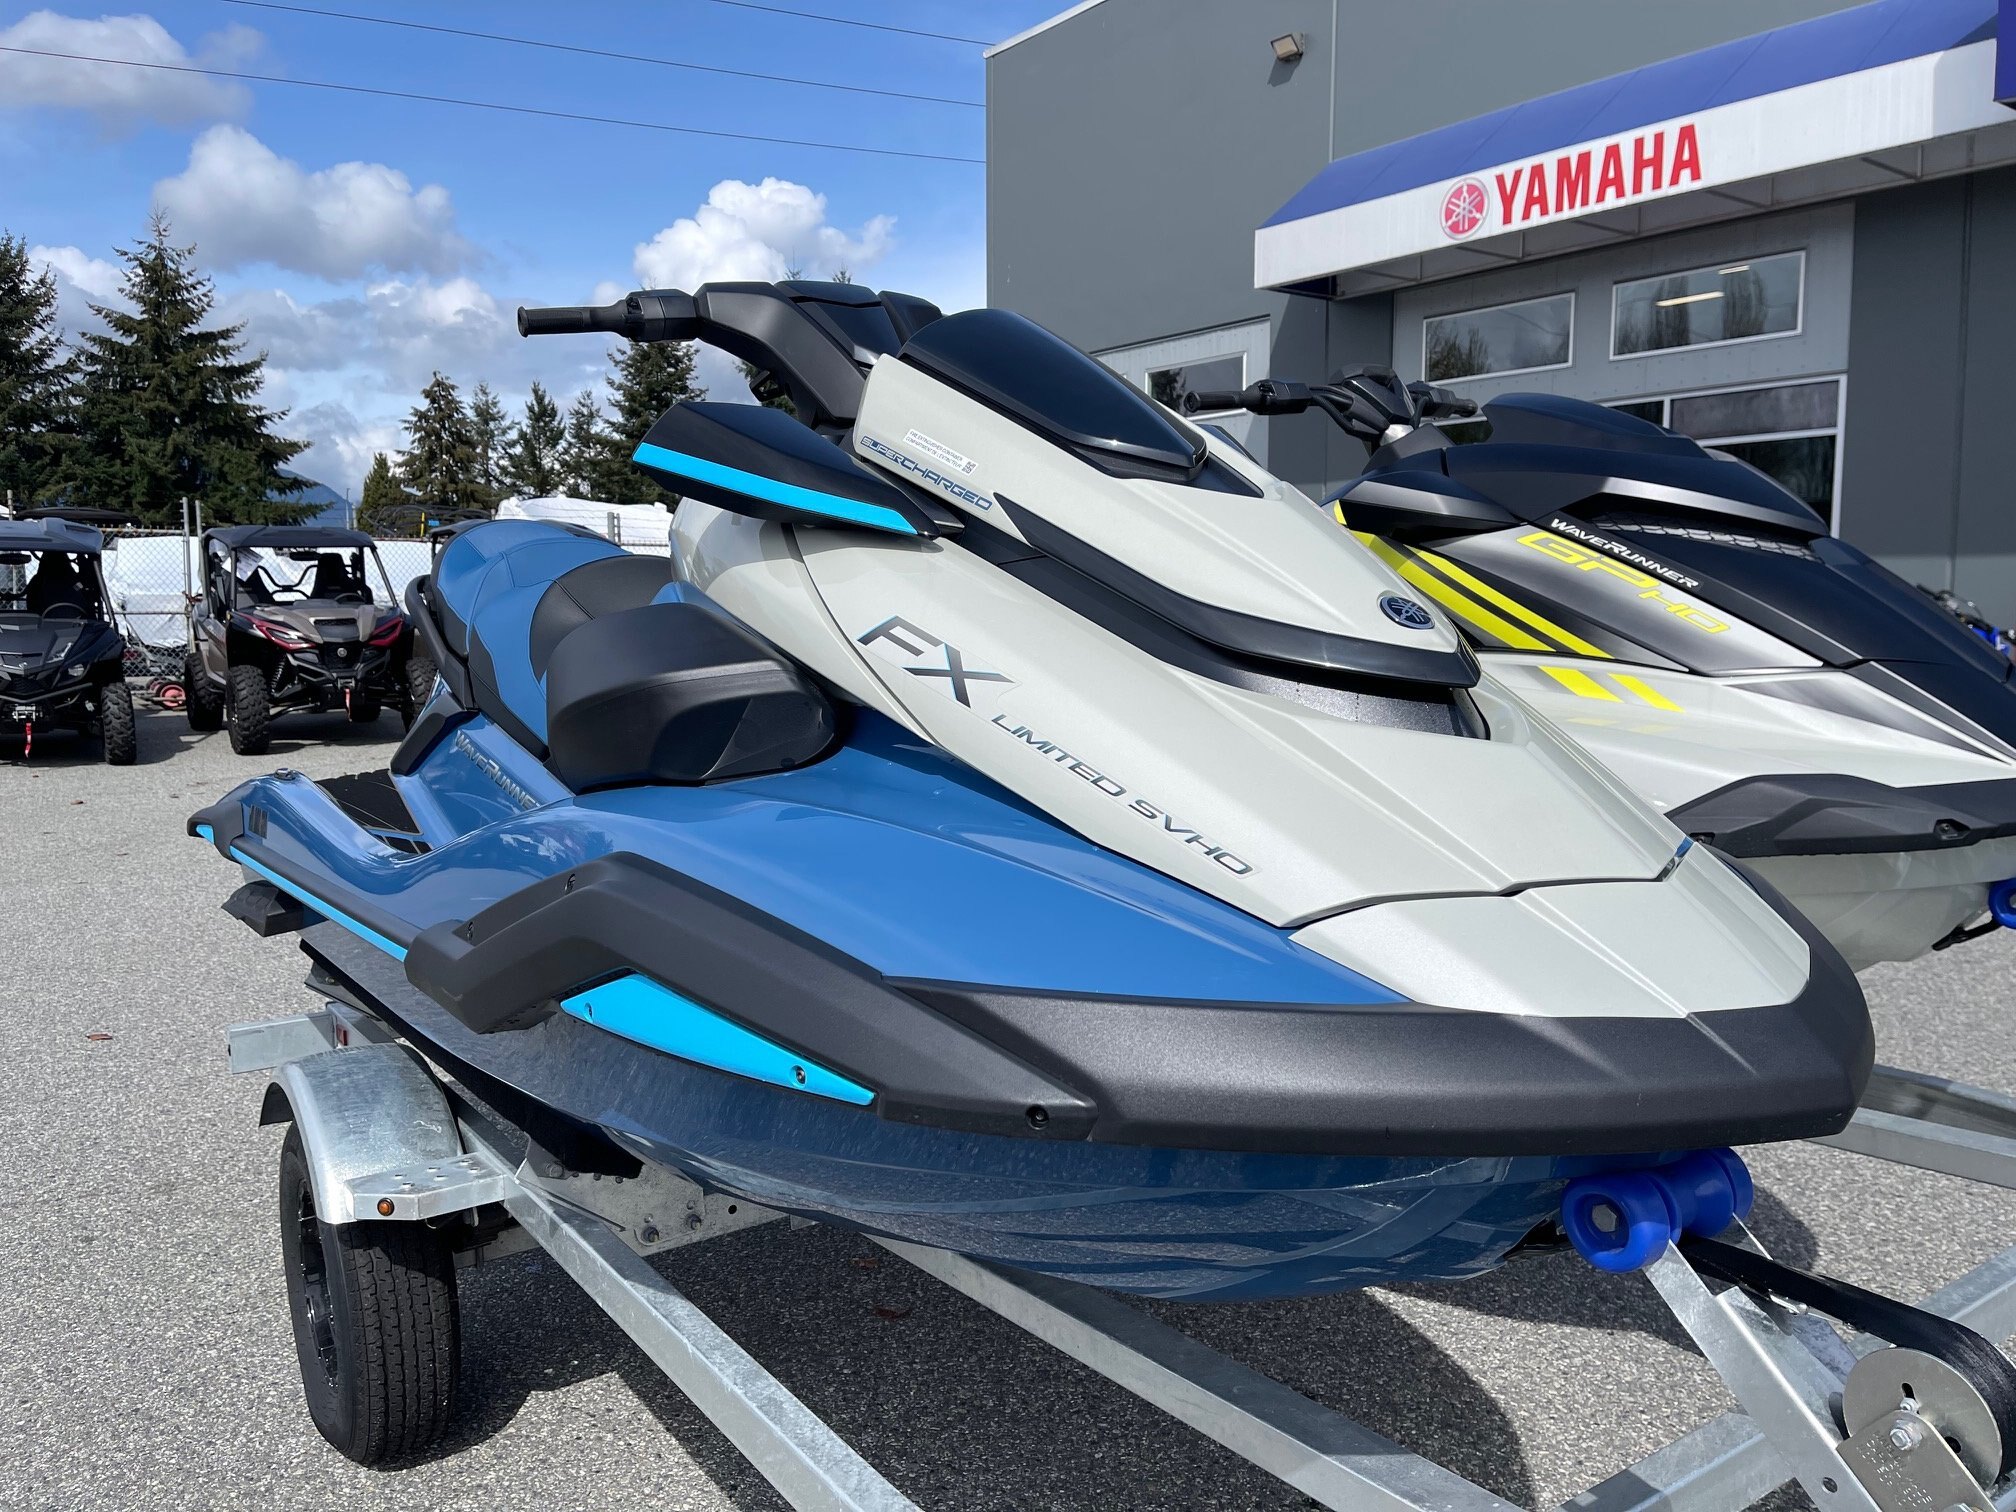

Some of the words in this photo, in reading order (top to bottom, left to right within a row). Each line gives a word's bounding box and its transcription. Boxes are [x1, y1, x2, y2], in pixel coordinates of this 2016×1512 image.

[1495, 123, 1702, 225] YAMAHA
[860, 435, 993, 511] SUPERCHARGED
[1516, 531, 1661, 590] GP
[1551, 518, 1699, 588] WAVERUNNER
[1638, 590, 1731, 634] HO
[857, 615, 1015, 708] FX
[991, 714, 1127, 797] LIMITED
[1128, 799, 1254, 876] SVHO
